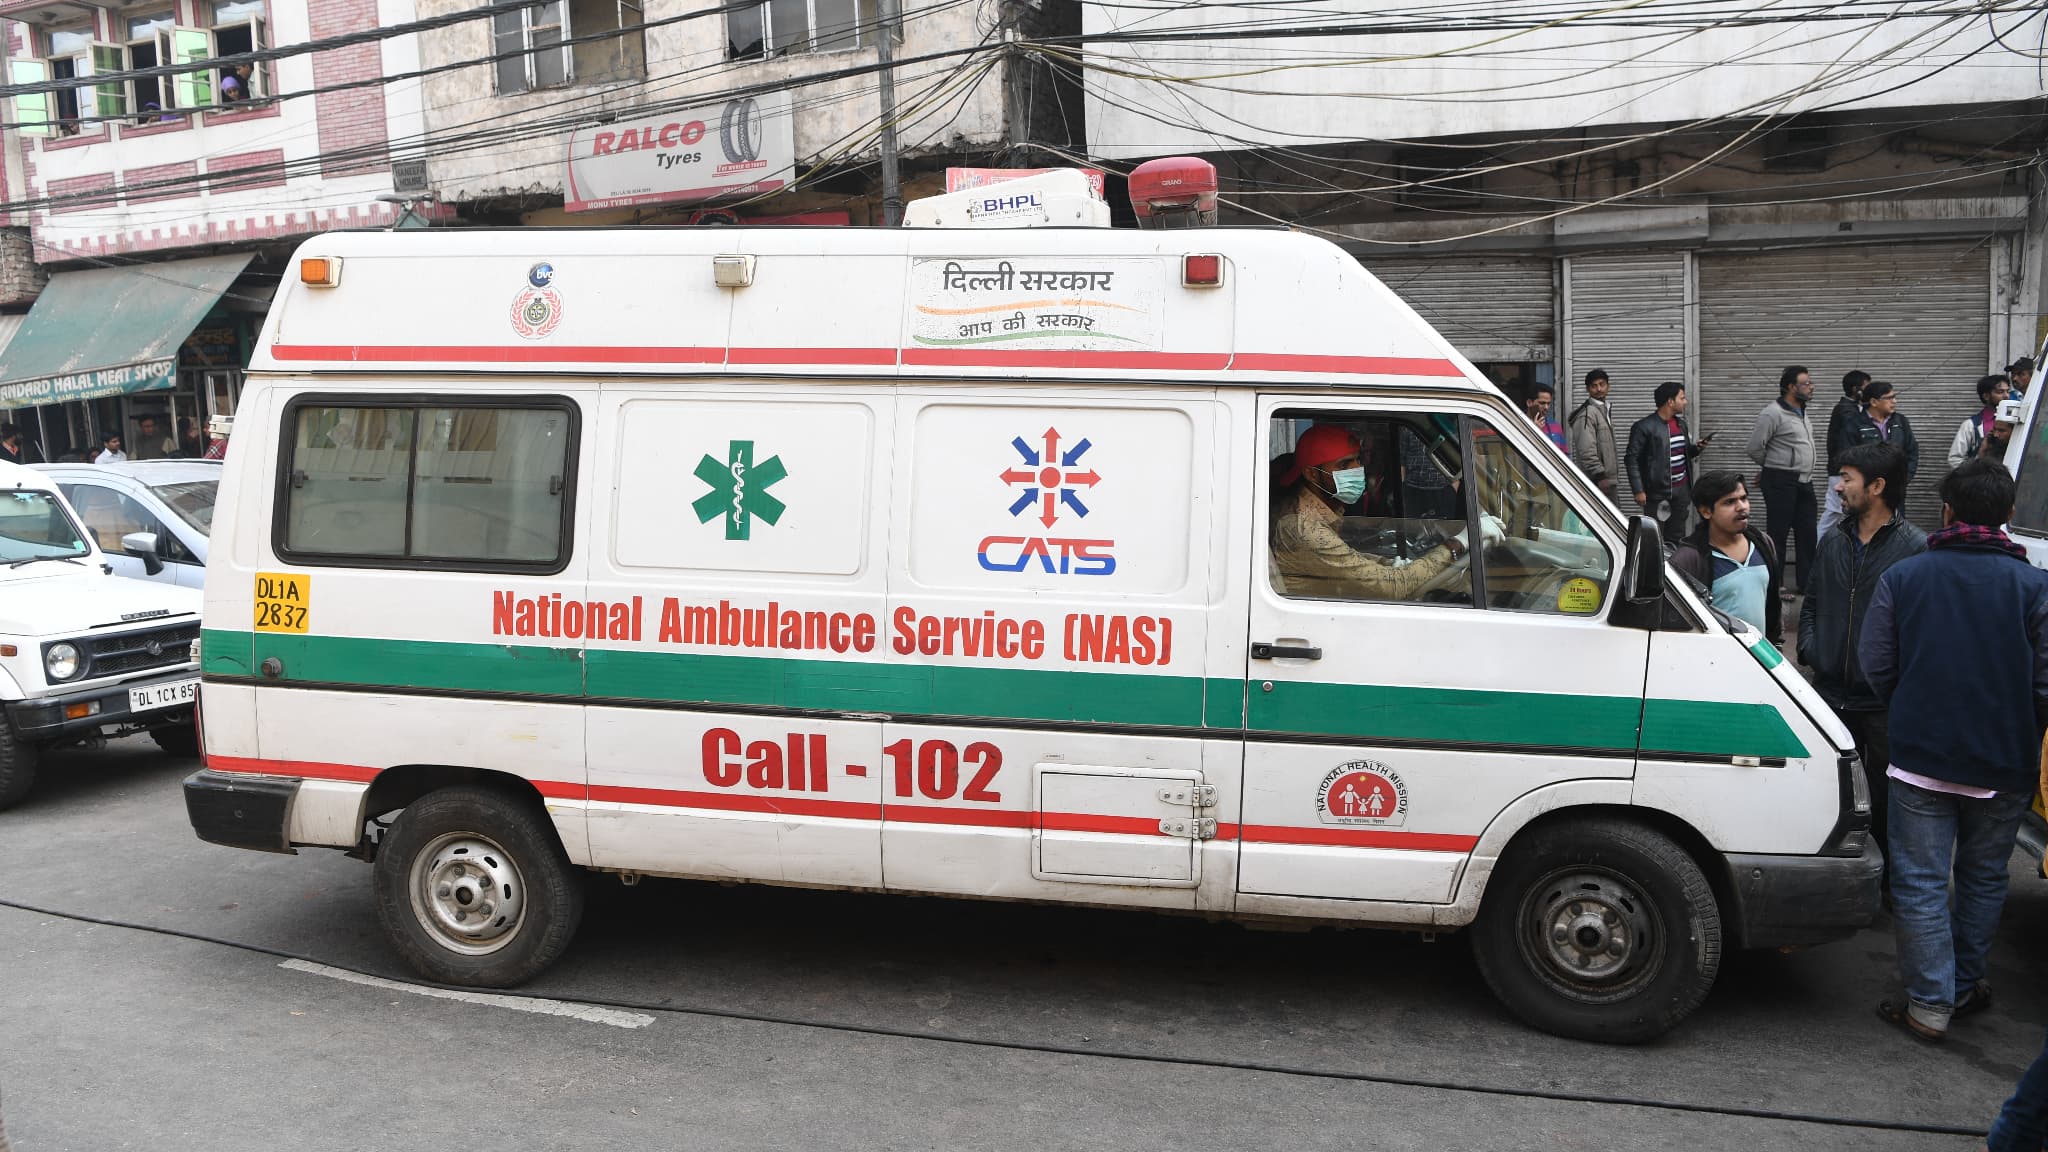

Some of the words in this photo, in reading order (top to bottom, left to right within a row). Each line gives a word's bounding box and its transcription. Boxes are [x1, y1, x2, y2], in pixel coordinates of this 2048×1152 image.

[592, 120, 706, 157] RALCO
[656, 152, 702, 170] Tyres
[587, 200, 609, 210] MONU
[610, 198, 633, 208] TYRES
[984, 194, 1042, 212] BHPL
[943, 261, 1015, 293] दिल्ली
[1020, 271, 1115, 291] सरकार
[959, 321, 993, 337] आप
[1002, 311, 1026, 331] की
[1036, 314, 1095, 331] सरकार
[54, 374, 94, 393] HALAL
[97, 368, 130, 386] MEAT
[134, 362, 172, 381] SHOP
[977, 535, 1117, 576] CATS
[257, 578, 300, 602] DL1A
[256, 601, 307, 629] 2837
[493, 590, 643, 642] National
[658, 597, 876, 654] Ambulance
[893, 605, 1045, 660] Service
[1063, 613, 1173, 666] (NAS)
[139, 692, 153, 706] DL
[157, 687, 177, 704] 1CX
[701, 727, 829, 793] Call
[845, 764, 867, 777] -
[883, 738, 1003, 803] 102
[1317, 767, 1346, 812] NATIONAL
[1347, 761, 1388, 776] HEALTH
[1388, 773, 1408, 814] MISSION
